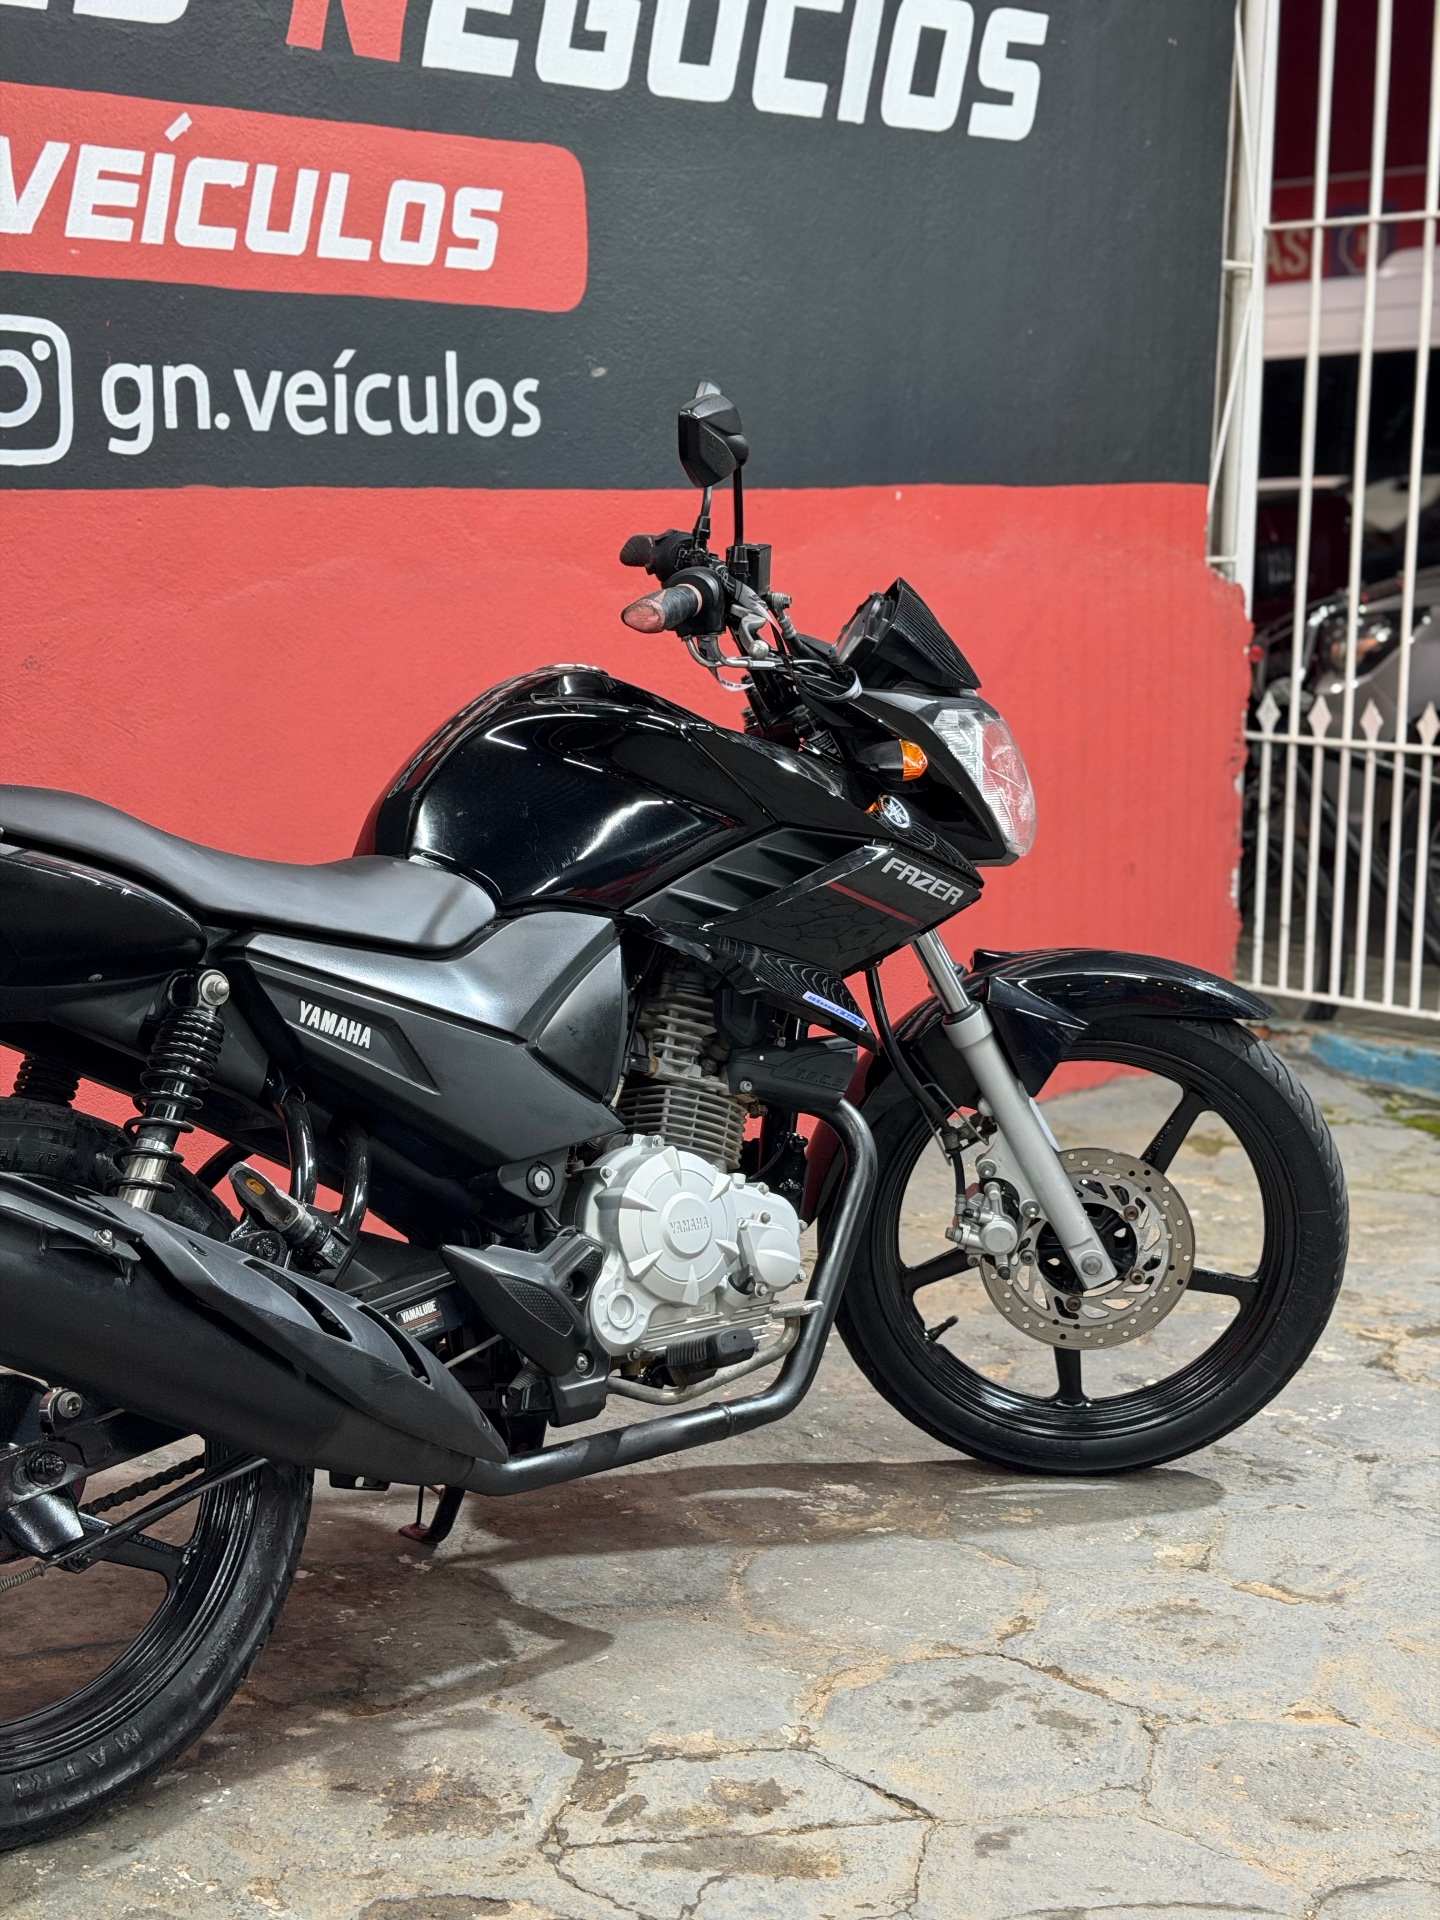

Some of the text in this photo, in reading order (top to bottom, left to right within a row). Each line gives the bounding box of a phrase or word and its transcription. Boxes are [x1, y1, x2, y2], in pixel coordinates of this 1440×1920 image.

[0, 112, 503, 271] VEÍCULOS
[101, 349, 542, 456] gn.veículos
[881, 857, 964, 906] FAZER
[299, 1000, 372, 1049] YAMAHA
[669, 1216, 710, 1235] YAMAHA
[400, 1300, 438, 1324] YAMALUBE
